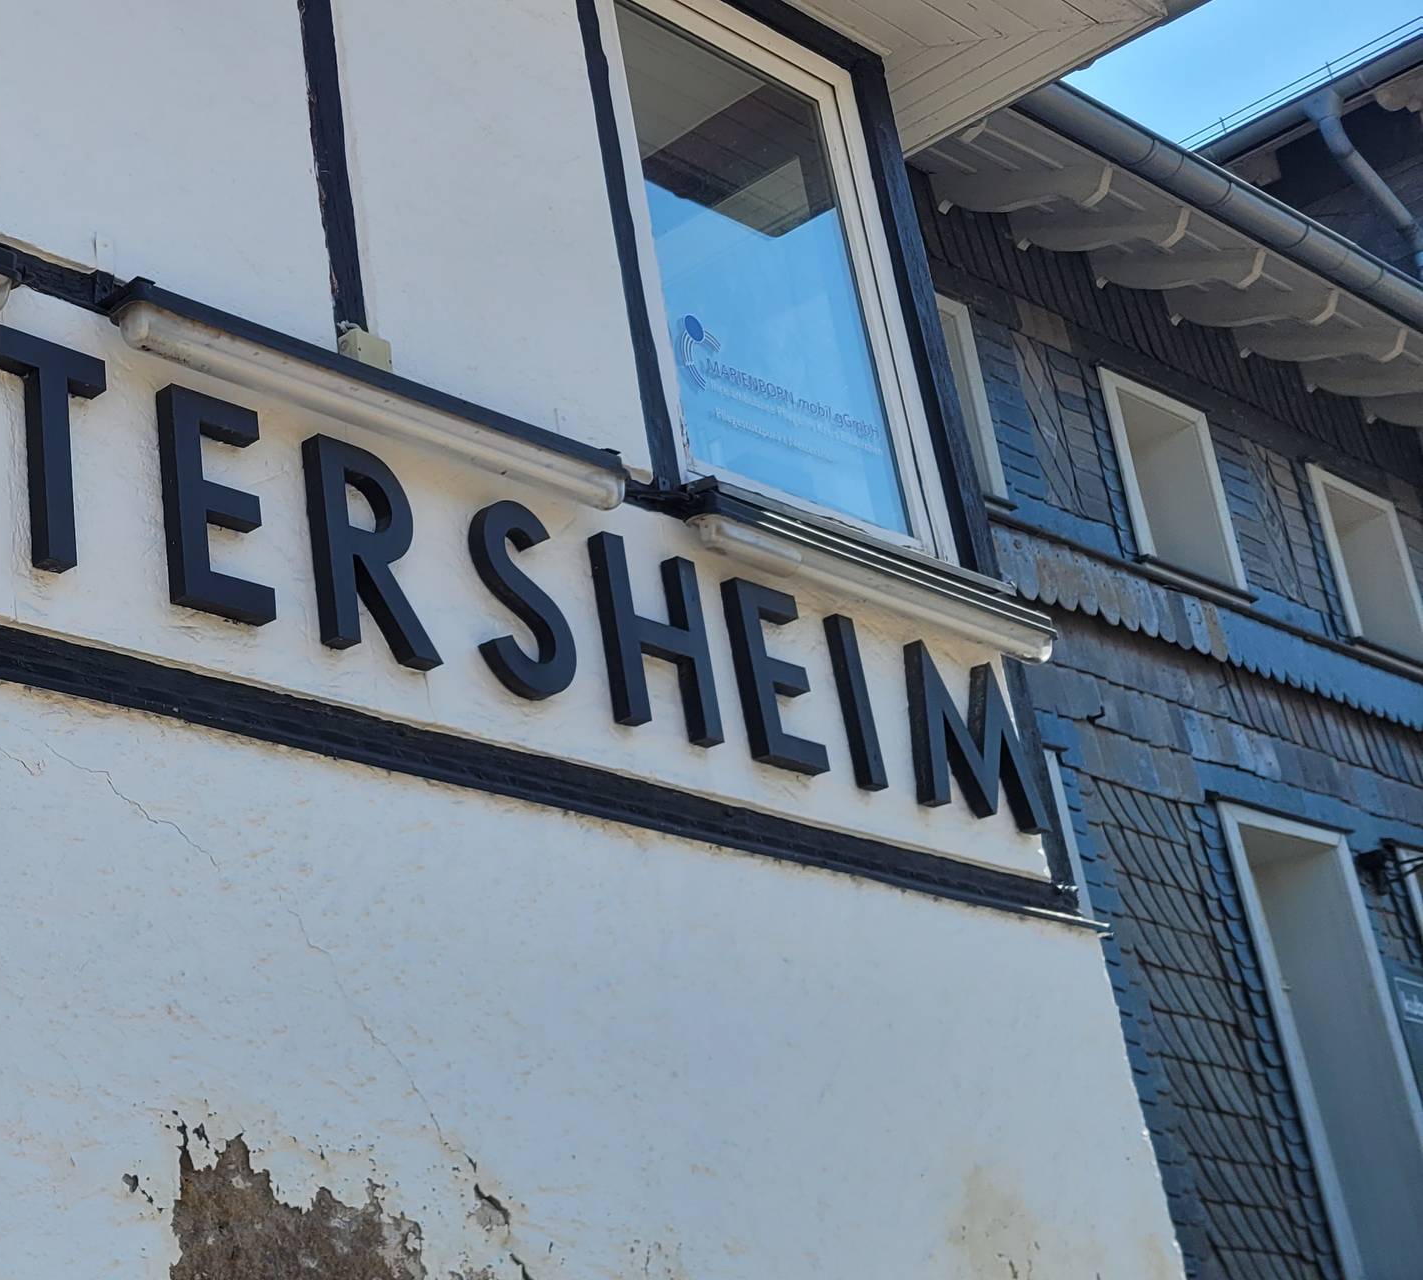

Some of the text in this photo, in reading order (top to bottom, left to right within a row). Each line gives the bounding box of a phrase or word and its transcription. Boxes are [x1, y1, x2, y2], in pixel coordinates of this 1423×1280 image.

[705, 357, 795, 405] MARIENBORN
[797, 398, 832, 421] mobil
[834, 410, 879, 440] gGmbH
